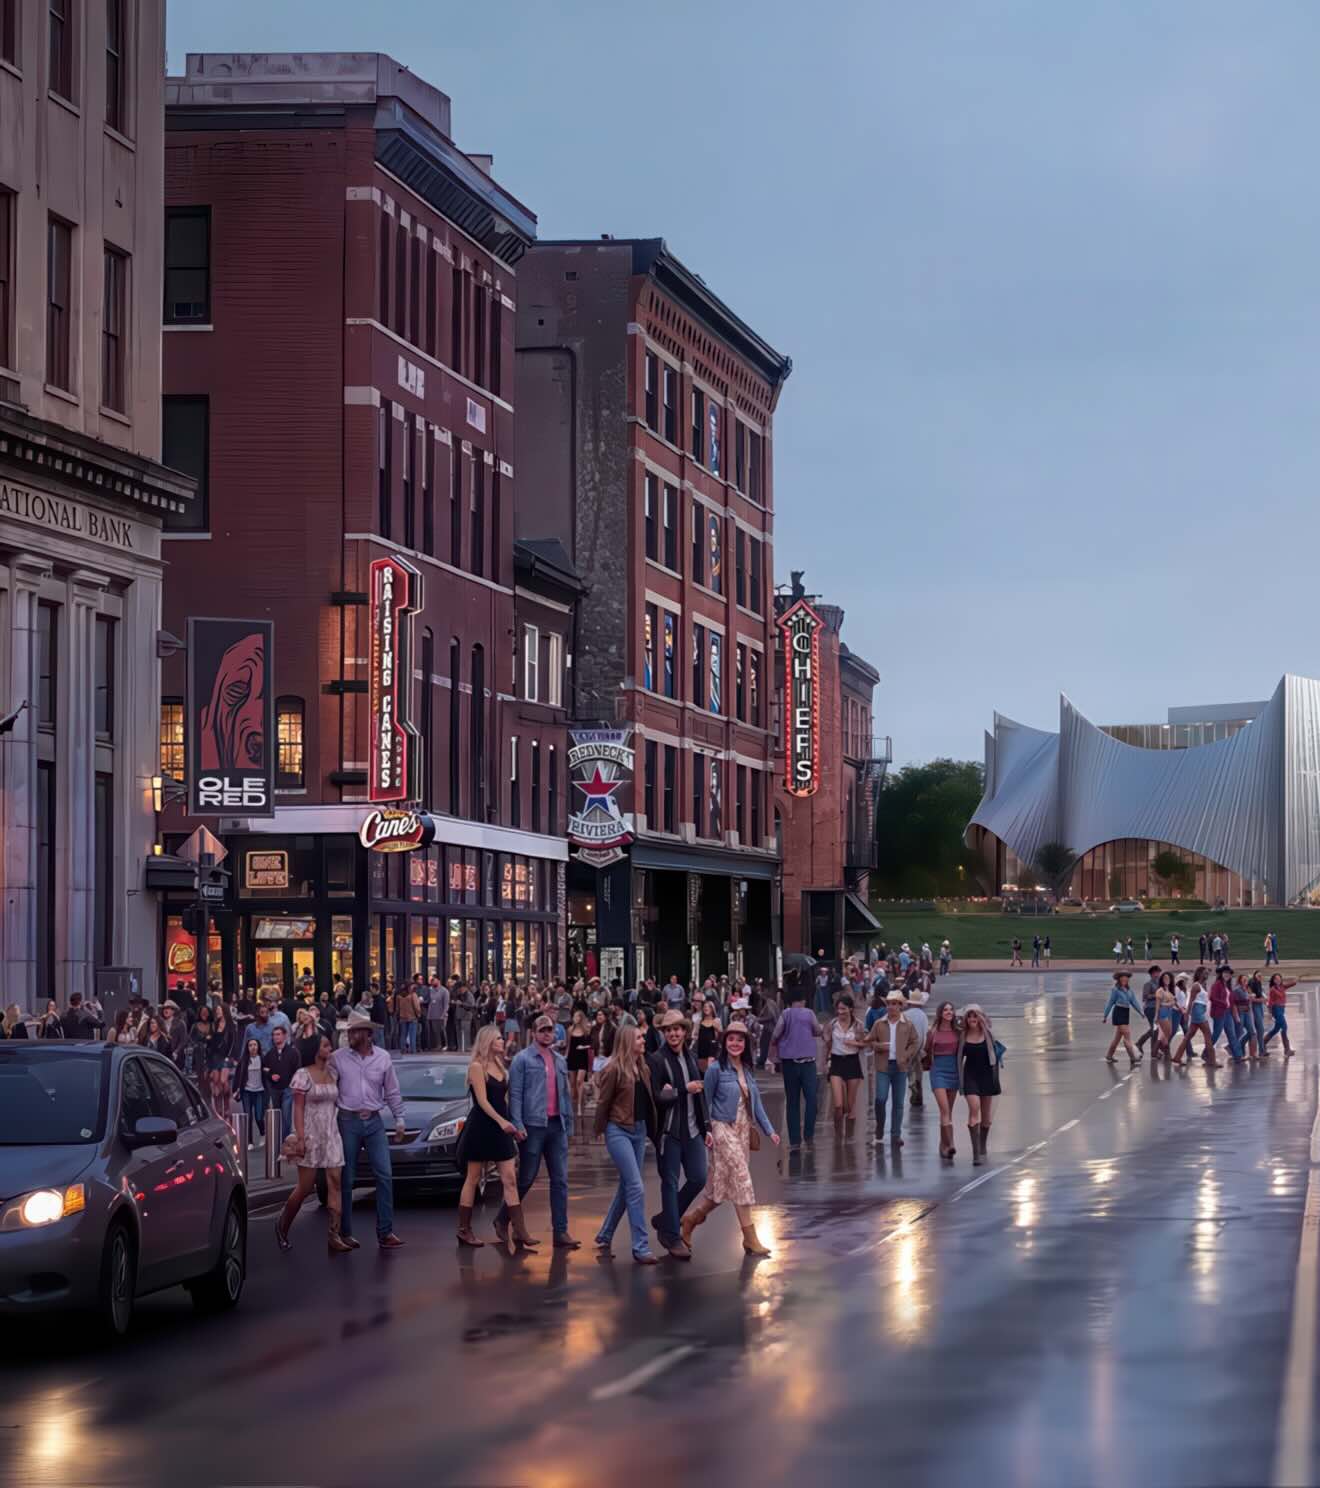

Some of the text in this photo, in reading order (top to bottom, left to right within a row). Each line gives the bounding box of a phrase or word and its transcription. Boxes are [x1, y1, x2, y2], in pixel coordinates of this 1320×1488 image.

[88, 511, 133, 548] BANK
[381, 567, 393, 789] RAISING CANES
[792, 632, 812, 781] CHIEFS
[199, 777, 266, 791] OLE
[199, 791, 266, 806] RED
